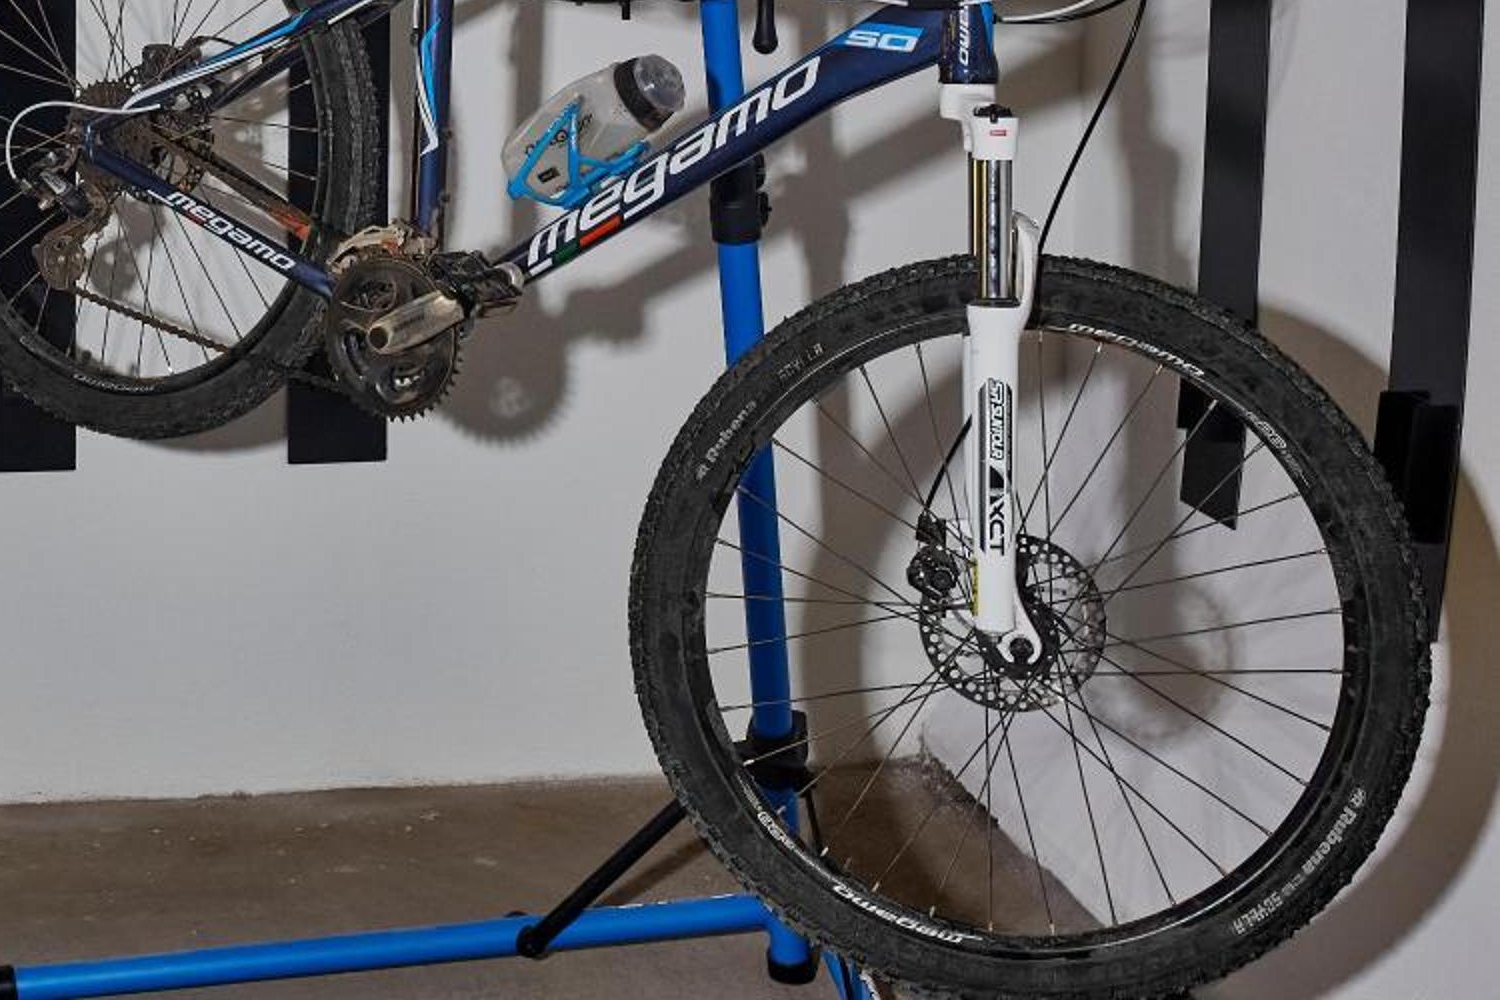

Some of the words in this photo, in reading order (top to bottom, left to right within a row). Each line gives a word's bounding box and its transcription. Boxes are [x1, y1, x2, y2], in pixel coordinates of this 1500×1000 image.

[527, 55, 821, 270] megamo
[166, 191, 298, 271] megamo
[989, 497, 1005, 556] XCT
[1301, 805, 1357, 876] Rubena
